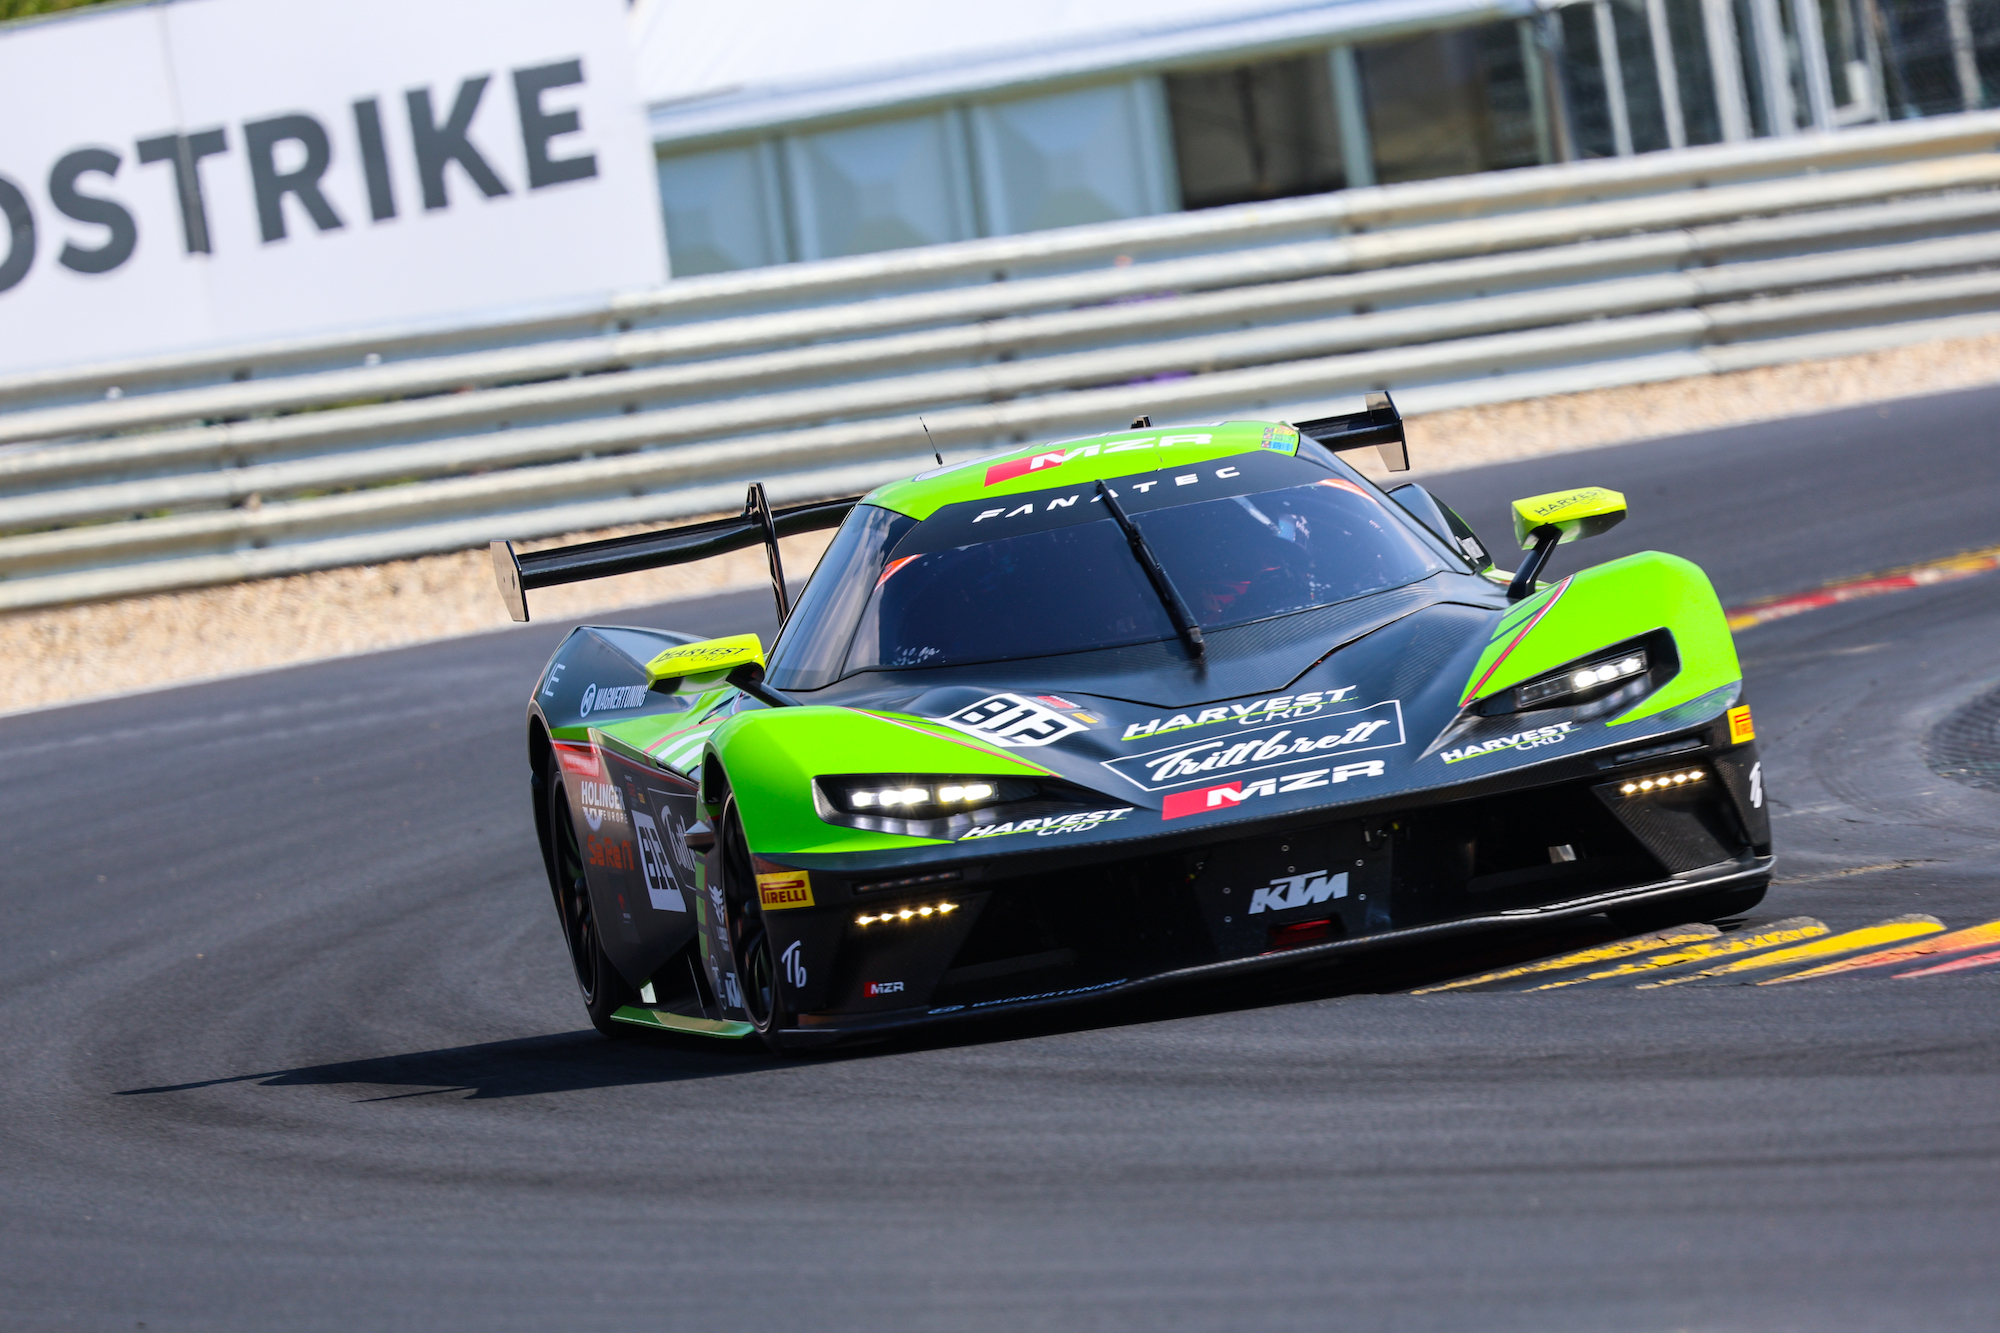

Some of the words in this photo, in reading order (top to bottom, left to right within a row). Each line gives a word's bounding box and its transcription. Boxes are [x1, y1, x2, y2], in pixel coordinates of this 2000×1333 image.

[1030, 434, 1213, 470] MZR
[593, 684, 650, 712] WAGNERTUNING
[1122, 684, 1358, 741] HARVEST
[949, 697, 1068, 745] 812
[1238, 704, 1323, 725] CRD
[1145, 719, 1391, 782] Trittbrett
[1440, 720, 1573, 763] HARVEST
[1515, 733, 1566, 751] CRD
[581, 780, 626, 811] HOLINGER
[1206, 759, 1386, 808] MZR
[602, 809, 628, 824] EUROPE
[960, 806, 1134, 839] HARVEST
[1036, 822, 1099, 837] CRD
[760, 879, 808, 905] PIRELLI
[1247, 868, 1349, 915] KTM
[871, 981, 905, 995] MZR
